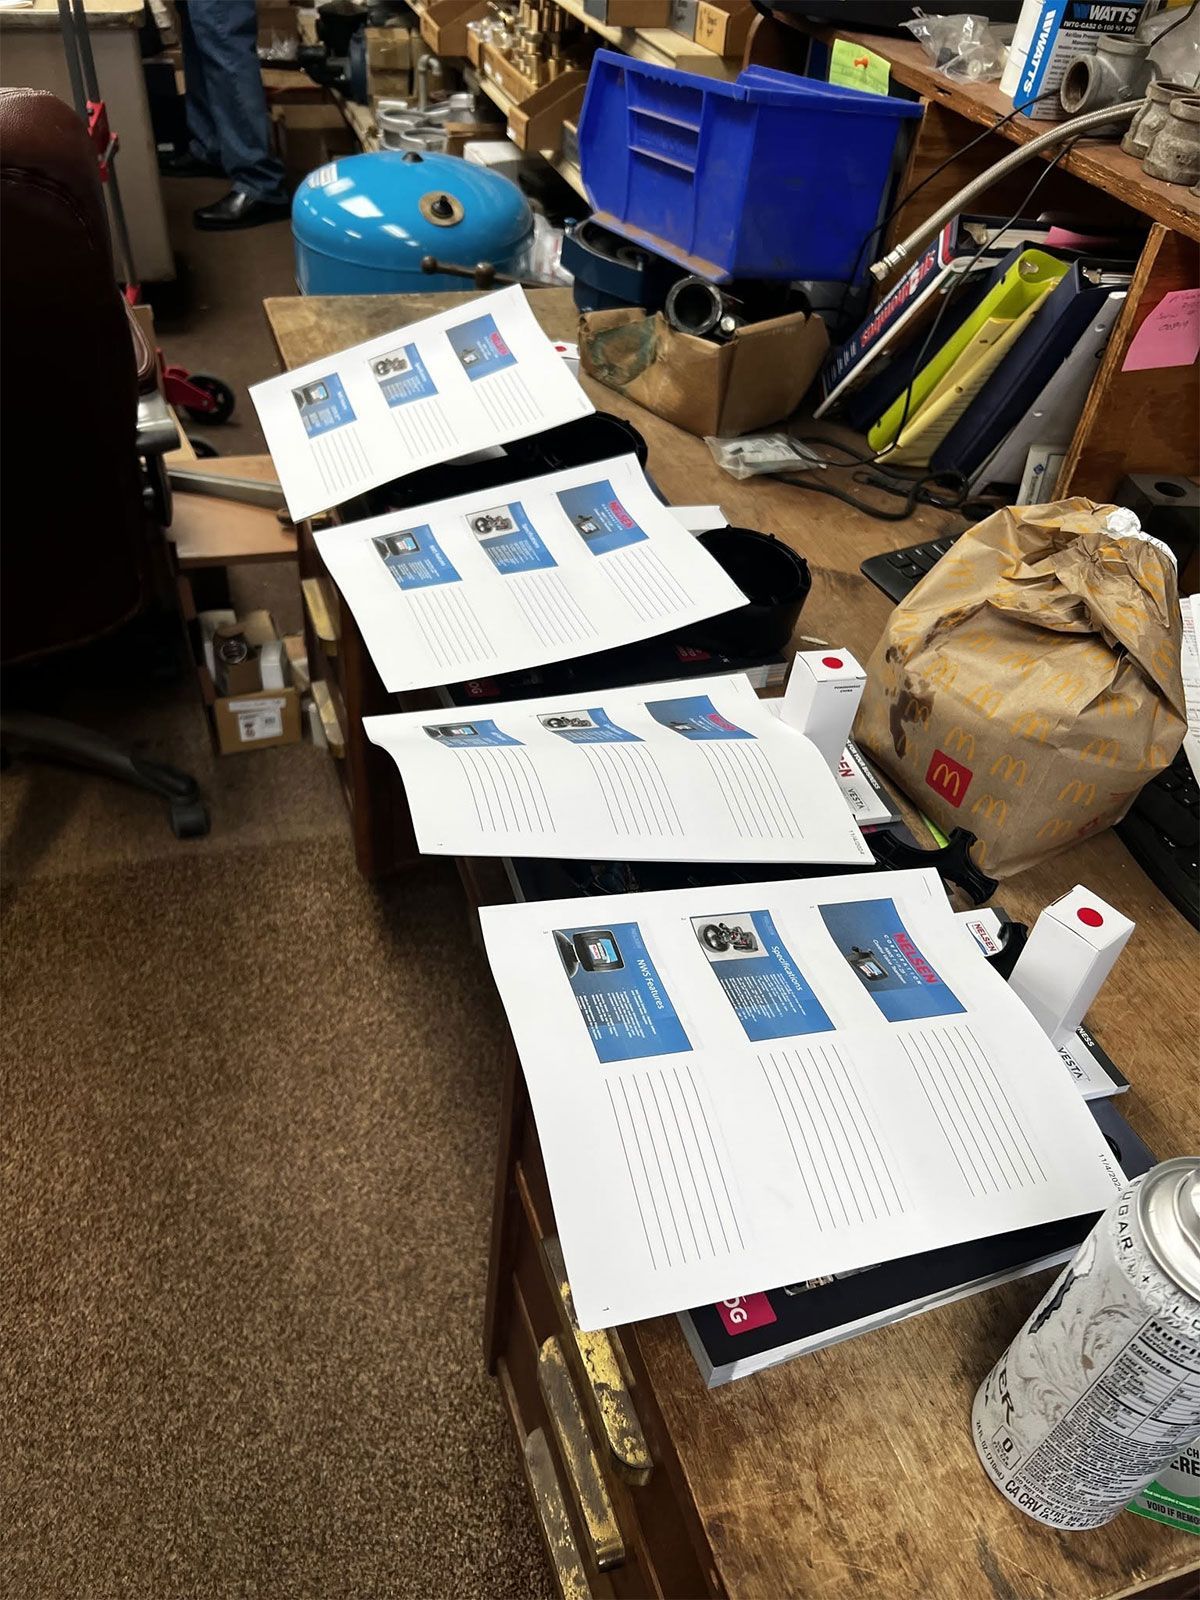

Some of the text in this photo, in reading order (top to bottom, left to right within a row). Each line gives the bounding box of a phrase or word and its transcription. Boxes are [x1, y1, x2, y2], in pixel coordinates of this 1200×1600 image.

[1088, 4, 1138, 23] WATTS
[1023, 31, 1049, 93] WATTS
[838, 756, 855, 778] EN
[848, 788, 866, 809] VESTA
[974, 923, 996, 952] NELSEN
[771, 945, 803, 992] Specifications
[892, 933, 938, 985] NELSEN
[636, 958, 651, 978] NWS
[645, 976, 665, 1010] Features
[1057, 1047, 1083, 1079] VESTA
[1098, 1153, 1122, 1192] 11/4/2024
[1130, 1343, 1172, 1374] Calories
[1005, 1480, 1043, 1512] CA CRV
[1146, 1500, 1166, 1515] VOID
